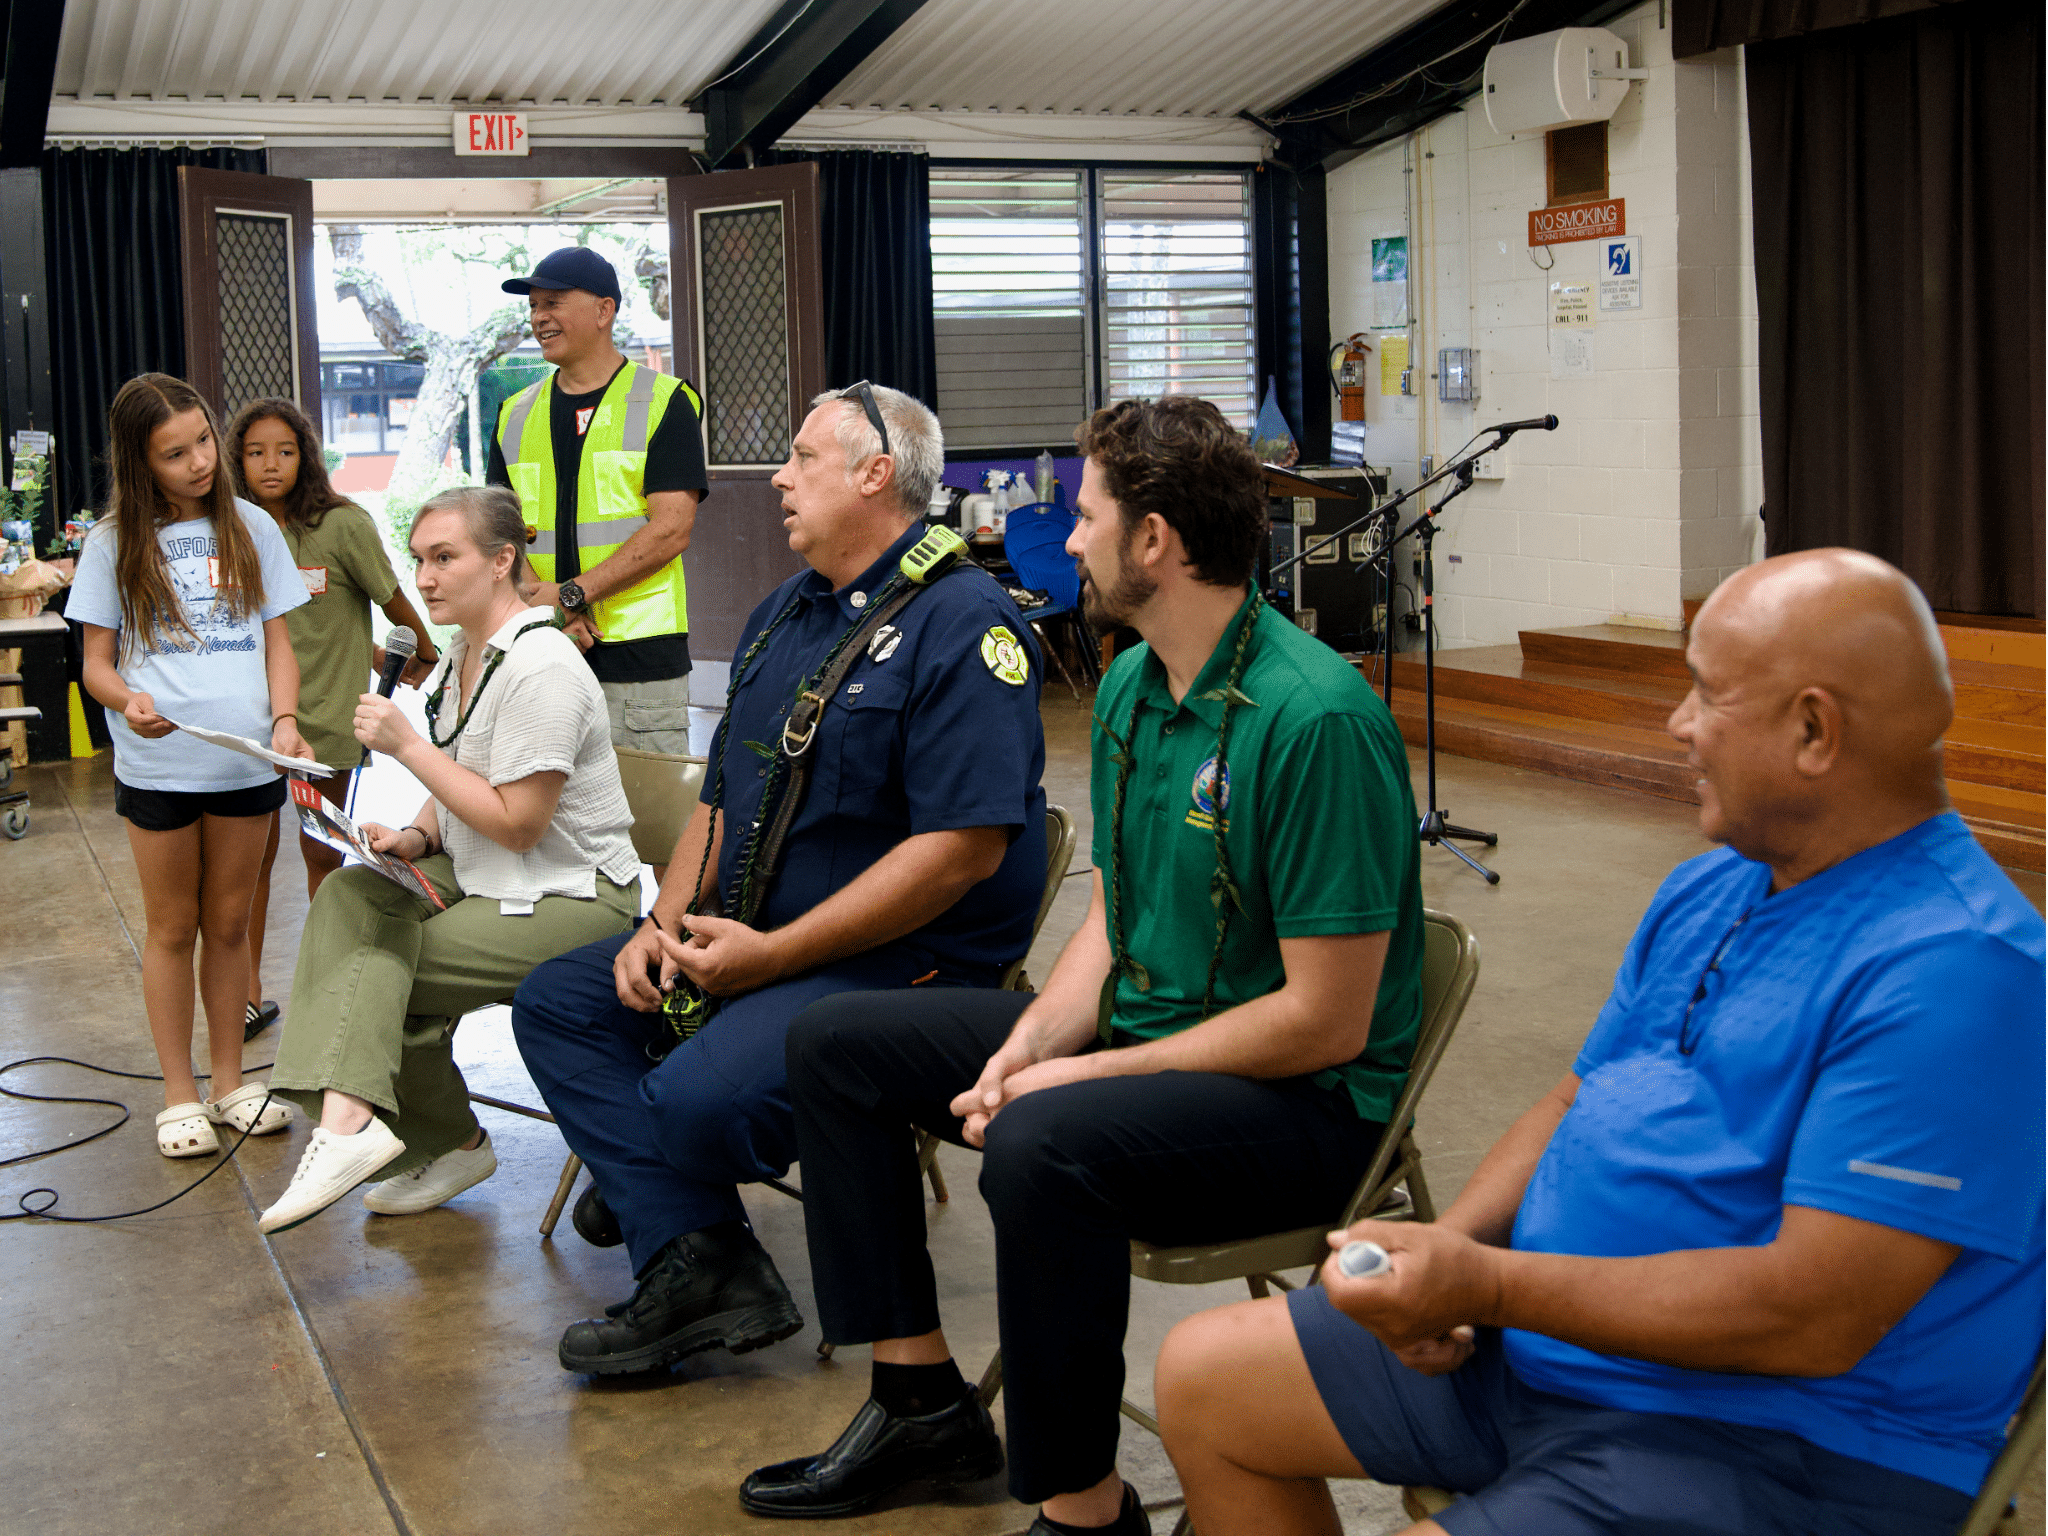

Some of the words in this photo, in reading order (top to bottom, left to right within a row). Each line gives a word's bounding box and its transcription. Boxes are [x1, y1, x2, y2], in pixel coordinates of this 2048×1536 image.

[469, 114, 517, 151] EXIT
[1534, 214, 1554, 232] NO
[1556, 205, 1617, 229] SMOKING
[1565, 228, 1595, 238] PROHIBITED
[1596, 226, 1604, 235] BY
[1604, 225, 1616, 233] LAW
[1555, 315, 1570, 324] CALL
[1576, 314, 1589, 323] 911
[197, 633, 258, 656] Nevada
